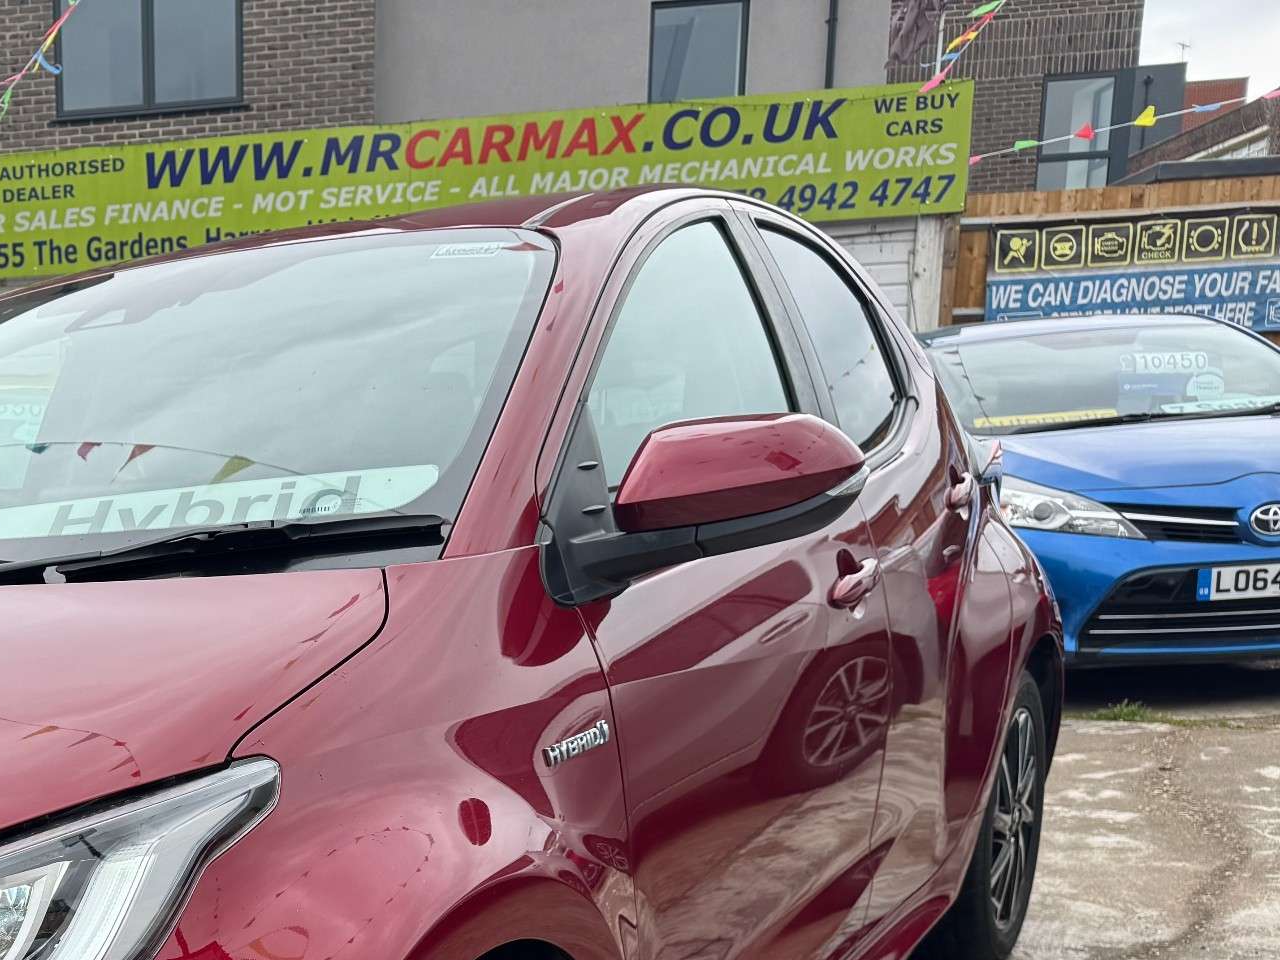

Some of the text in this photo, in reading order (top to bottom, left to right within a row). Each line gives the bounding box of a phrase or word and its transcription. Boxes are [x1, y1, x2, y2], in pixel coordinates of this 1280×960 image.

[874, 92, 960, 114] WE BUY
[144, 96, 847, 190] WWW.MRCARMAX.CO.UK
[886, 117, 944, 137] CARS
[0, 157, 125, 181] AUTHORISED
[2, 184, 76, 203] DEALER
[13, 206, 96, 233] SALES
[104, 196, 224, 226] FINANCE
[252, 188, 314, 215] MOT
[320, 180, 442, 210] SERVICE
[470, 174, 520, 200] ALL
[530, 166, 629, 195] MAJOR
[638, 151, 832, 186] MECHANICAL
[844, 142, 959, 173] WORKS
[777, 180, 859, 212] 4942
[869, 174, 956, 208] 4747
[32, 239, 78, 266] The
[1141, 250, 1171, 260] CHECK
[991, 283, 1022, 310] WE
[1027, 281, 1073, 308] CAN
[1076, 274, 1188, 306] DIAGNOSE
[1194, 271, 1251, 298] YOUR
[48, 475, 362, 537] Hybrid
[542, 727, 601, 768] HYBRID
